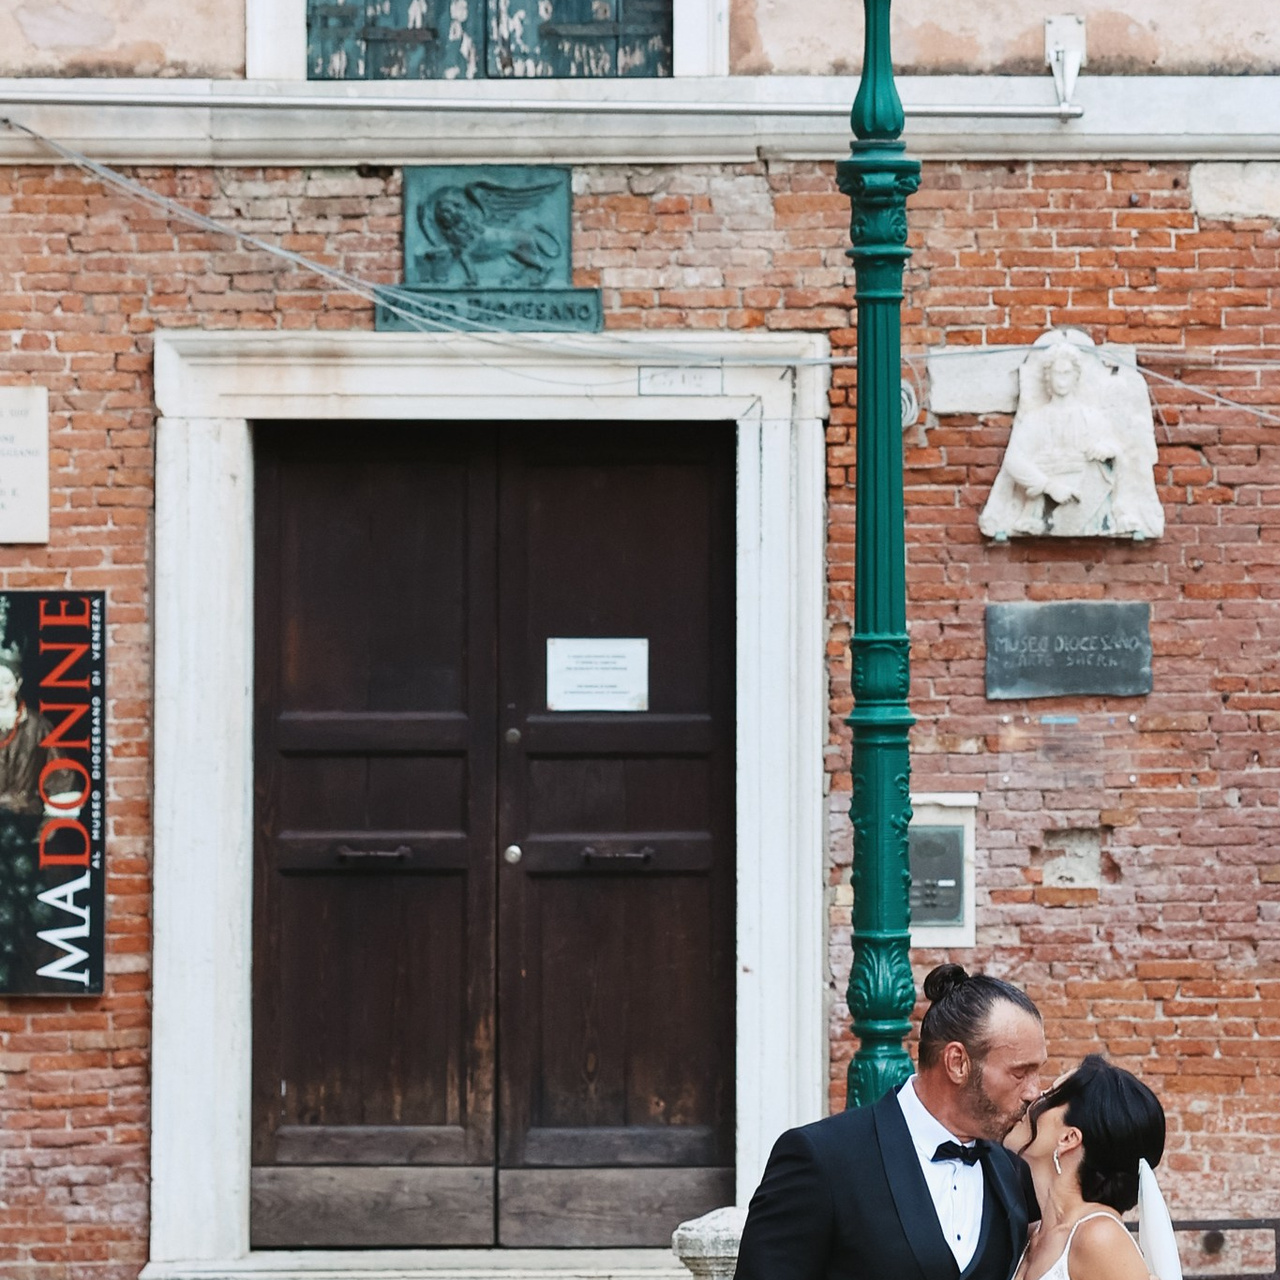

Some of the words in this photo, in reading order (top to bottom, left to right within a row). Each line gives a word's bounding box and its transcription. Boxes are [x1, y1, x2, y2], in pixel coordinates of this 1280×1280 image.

[91, 597, 101, 661] VENEZIA
[91, 670, 101, 687] DI
[91, 696, 101, 780] DIOCESANO
[36, 597, 91, 987] MADONNE
[91, 790, 101, 841] MUSEO
[91, 851, 101, 869] AL
